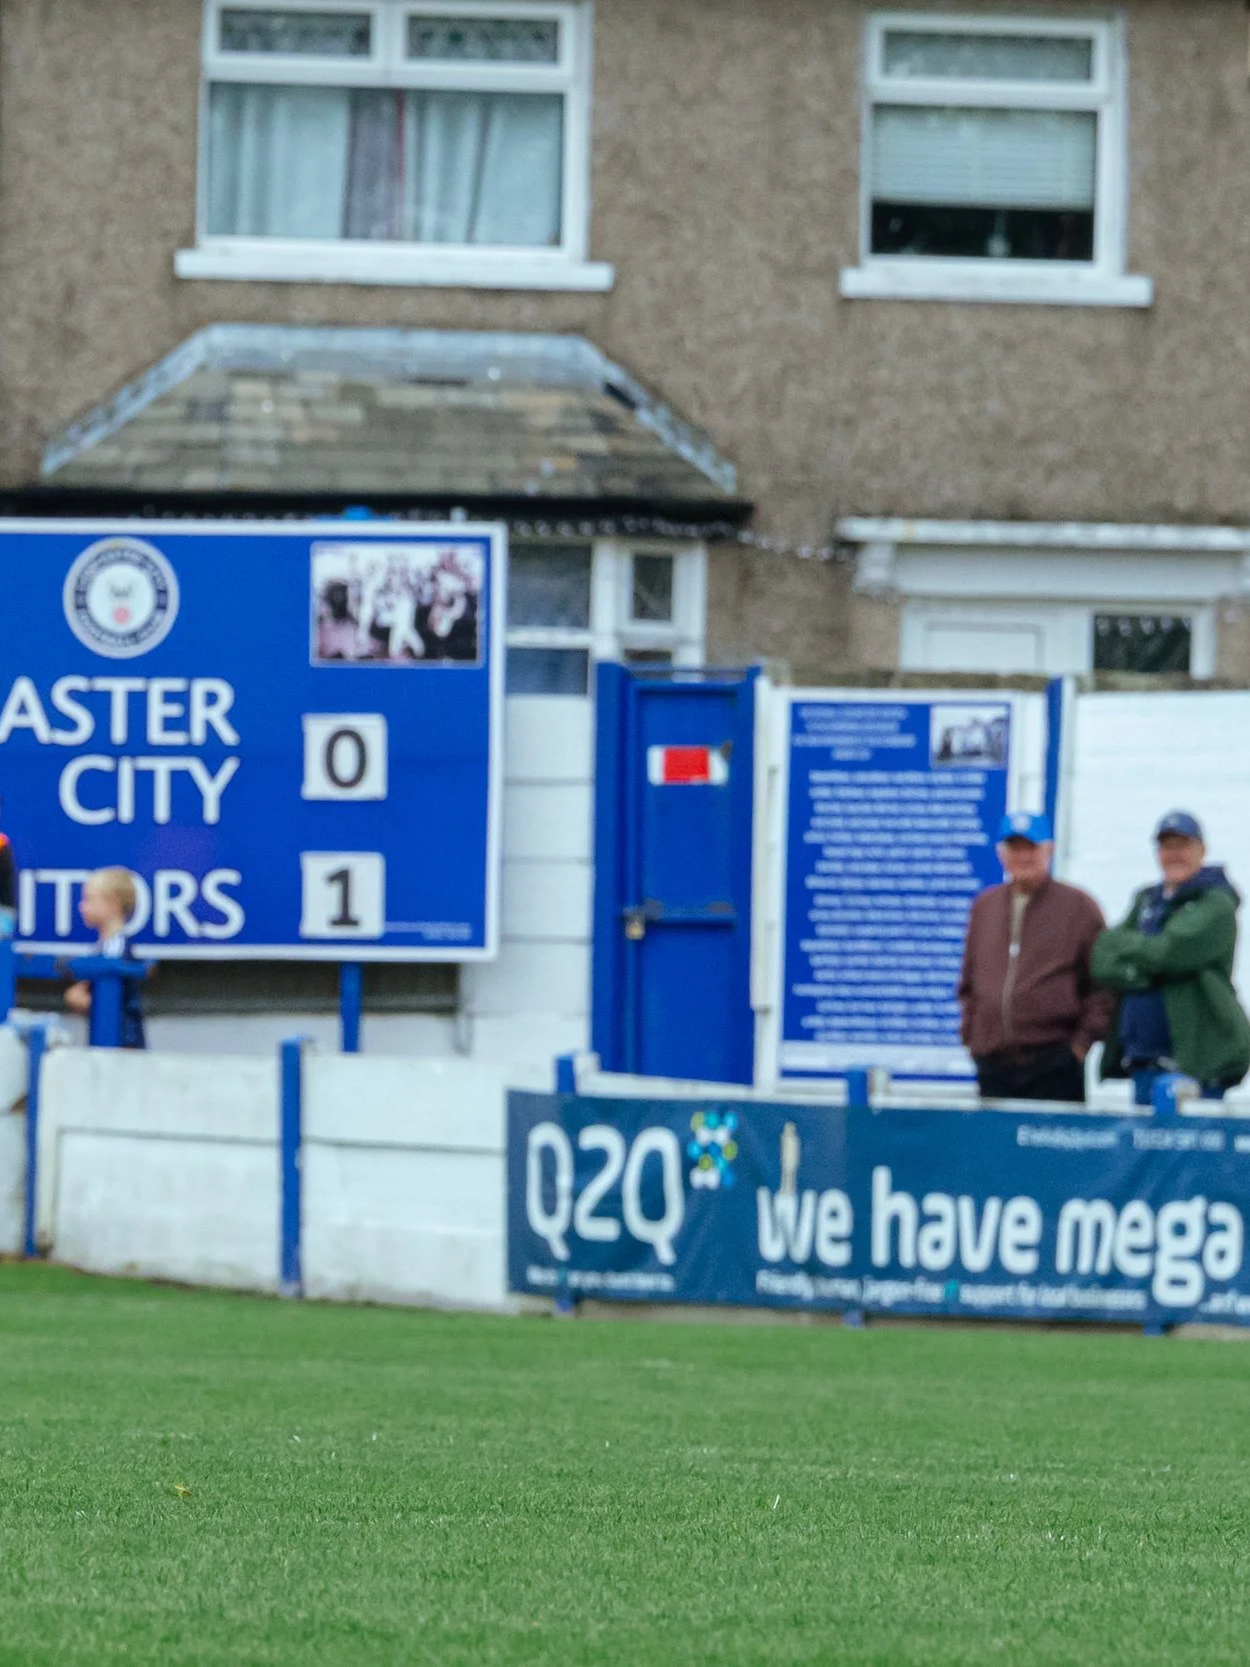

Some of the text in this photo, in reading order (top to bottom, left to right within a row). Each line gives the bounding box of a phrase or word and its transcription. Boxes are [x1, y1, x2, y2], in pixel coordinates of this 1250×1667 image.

[58, 755, 241, 827] CITY
[324, 727, 368, 790] 0
[324, 865, 360, 928] 1
[526, 1121, 685, 1266] Q2Q
[756, 1165, 1244, 1307] we have mega
